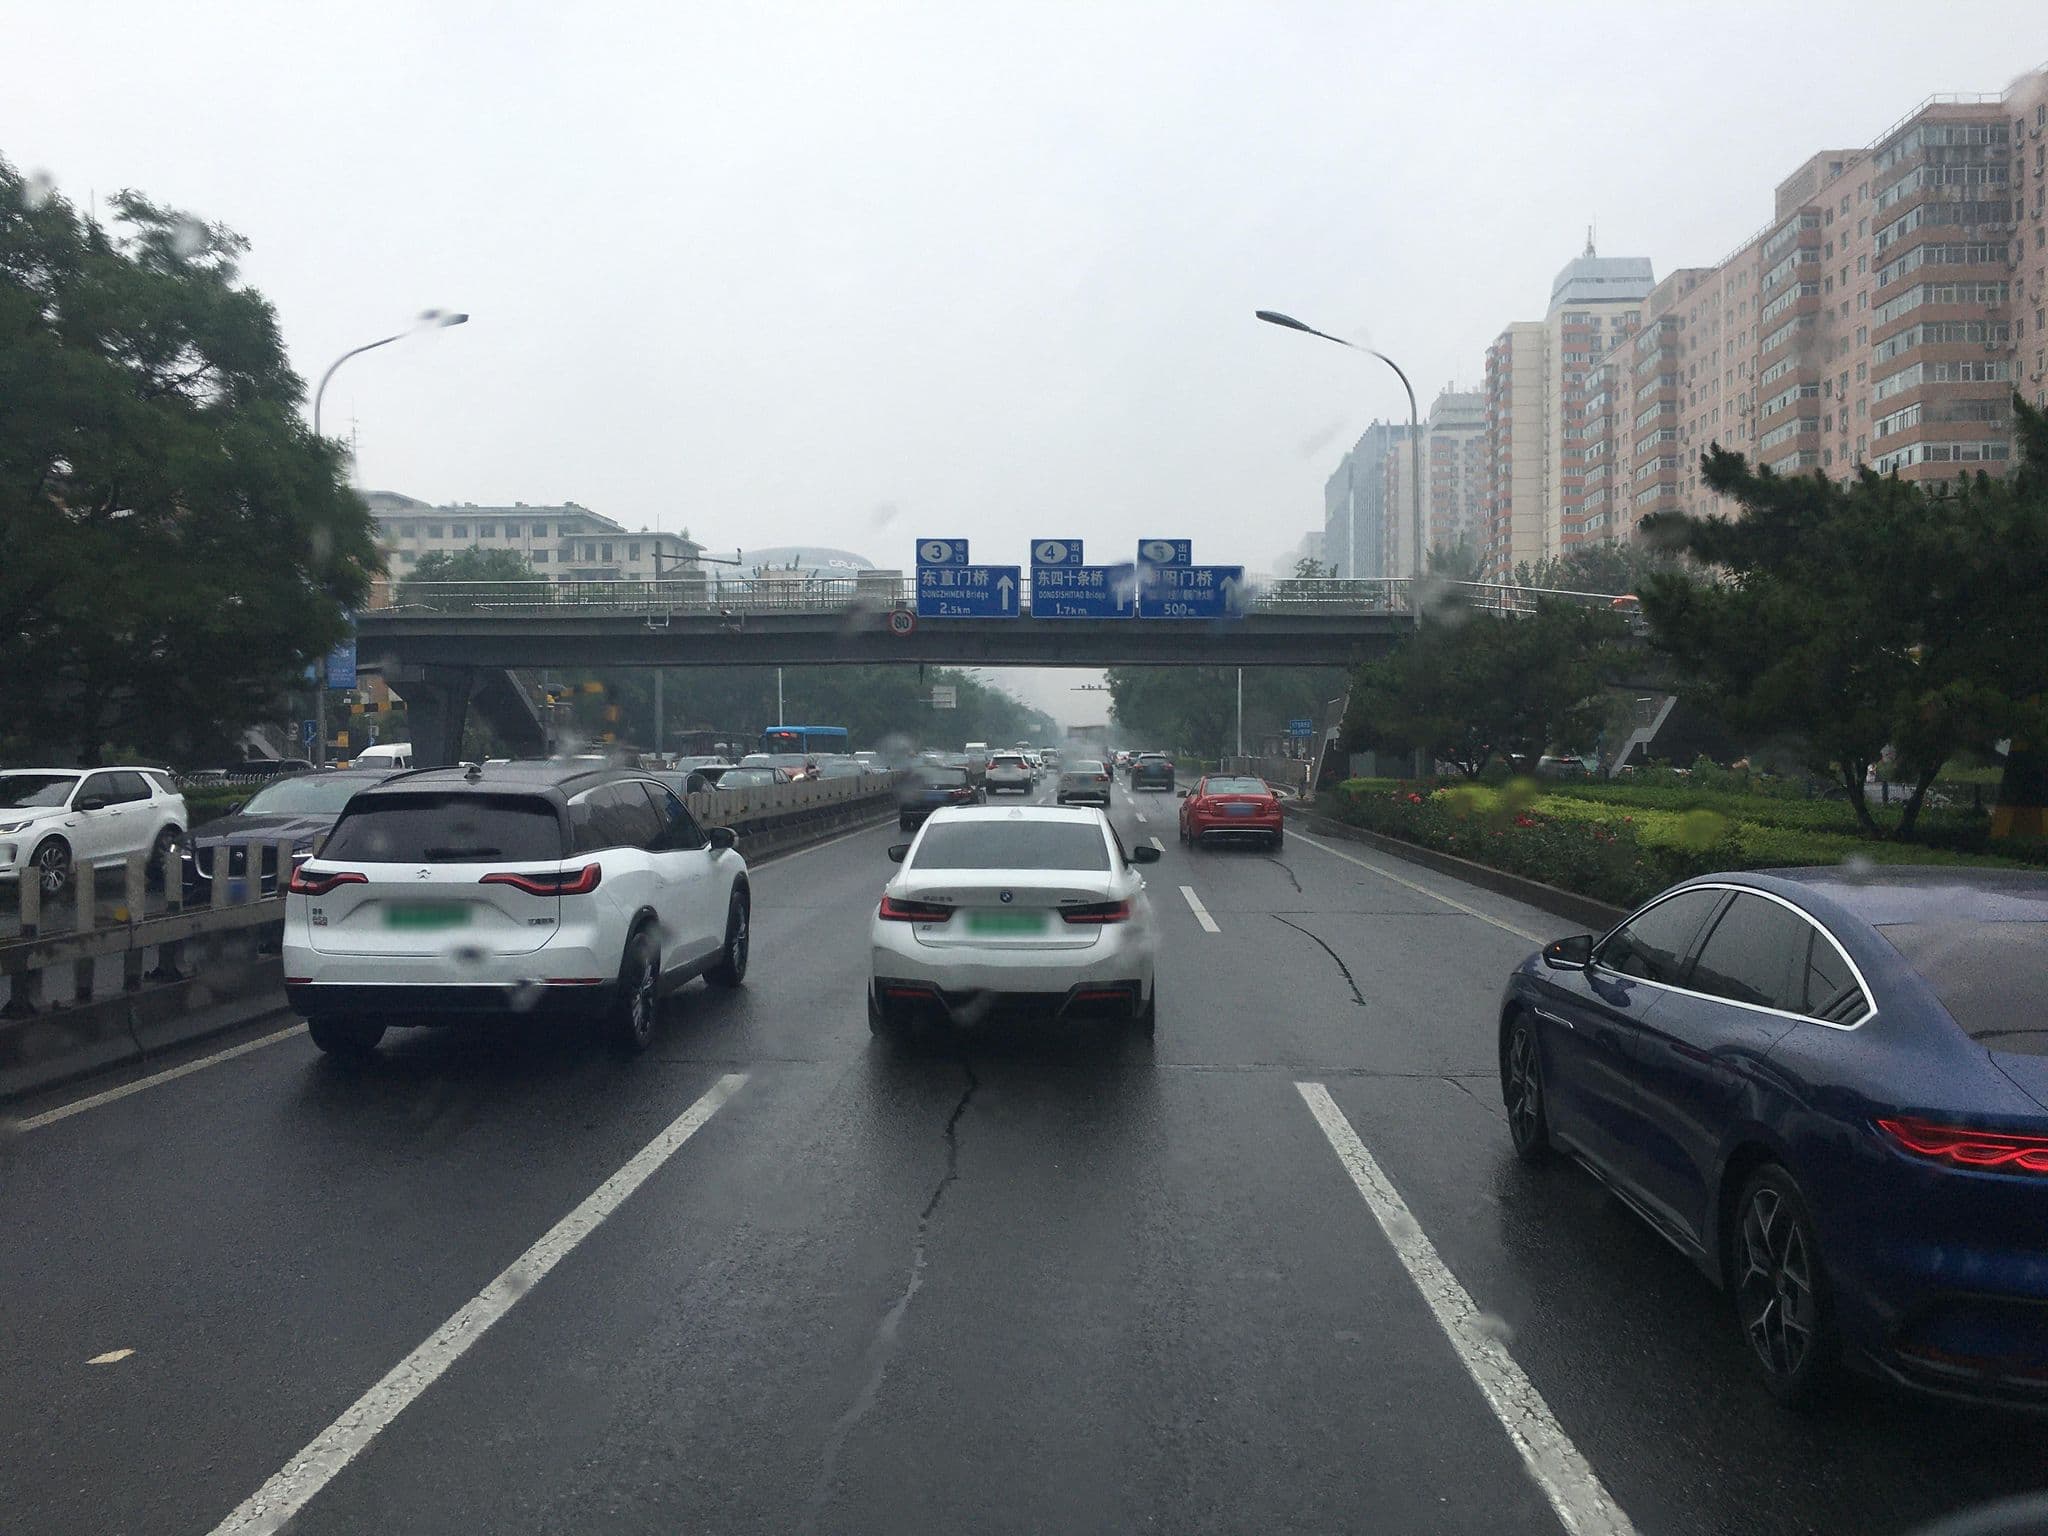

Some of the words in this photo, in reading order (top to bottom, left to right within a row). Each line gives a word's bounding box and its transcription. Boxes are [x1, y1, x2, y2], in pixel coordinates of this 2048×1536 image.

[931, 545, 942, 559] 3
[955, 543, 965, 562] 出口
[1044, 545, 1055, 560] 4
[1070, 543, 1080, 563] 出口
[1178, 543, 1187, 562] 出口
[922, 569, 989, 587] 东直门桥
[1038, 570, 1104, 587] 东四十条桥
[966, 590, 989, 601] Bridge
[940, 602, 971, 614] 2.5km
[1055, 603, 1087, 615] 1.7km
[1164, 603, 1196, 615] 500m
[895, 615, 909, 629] 80
